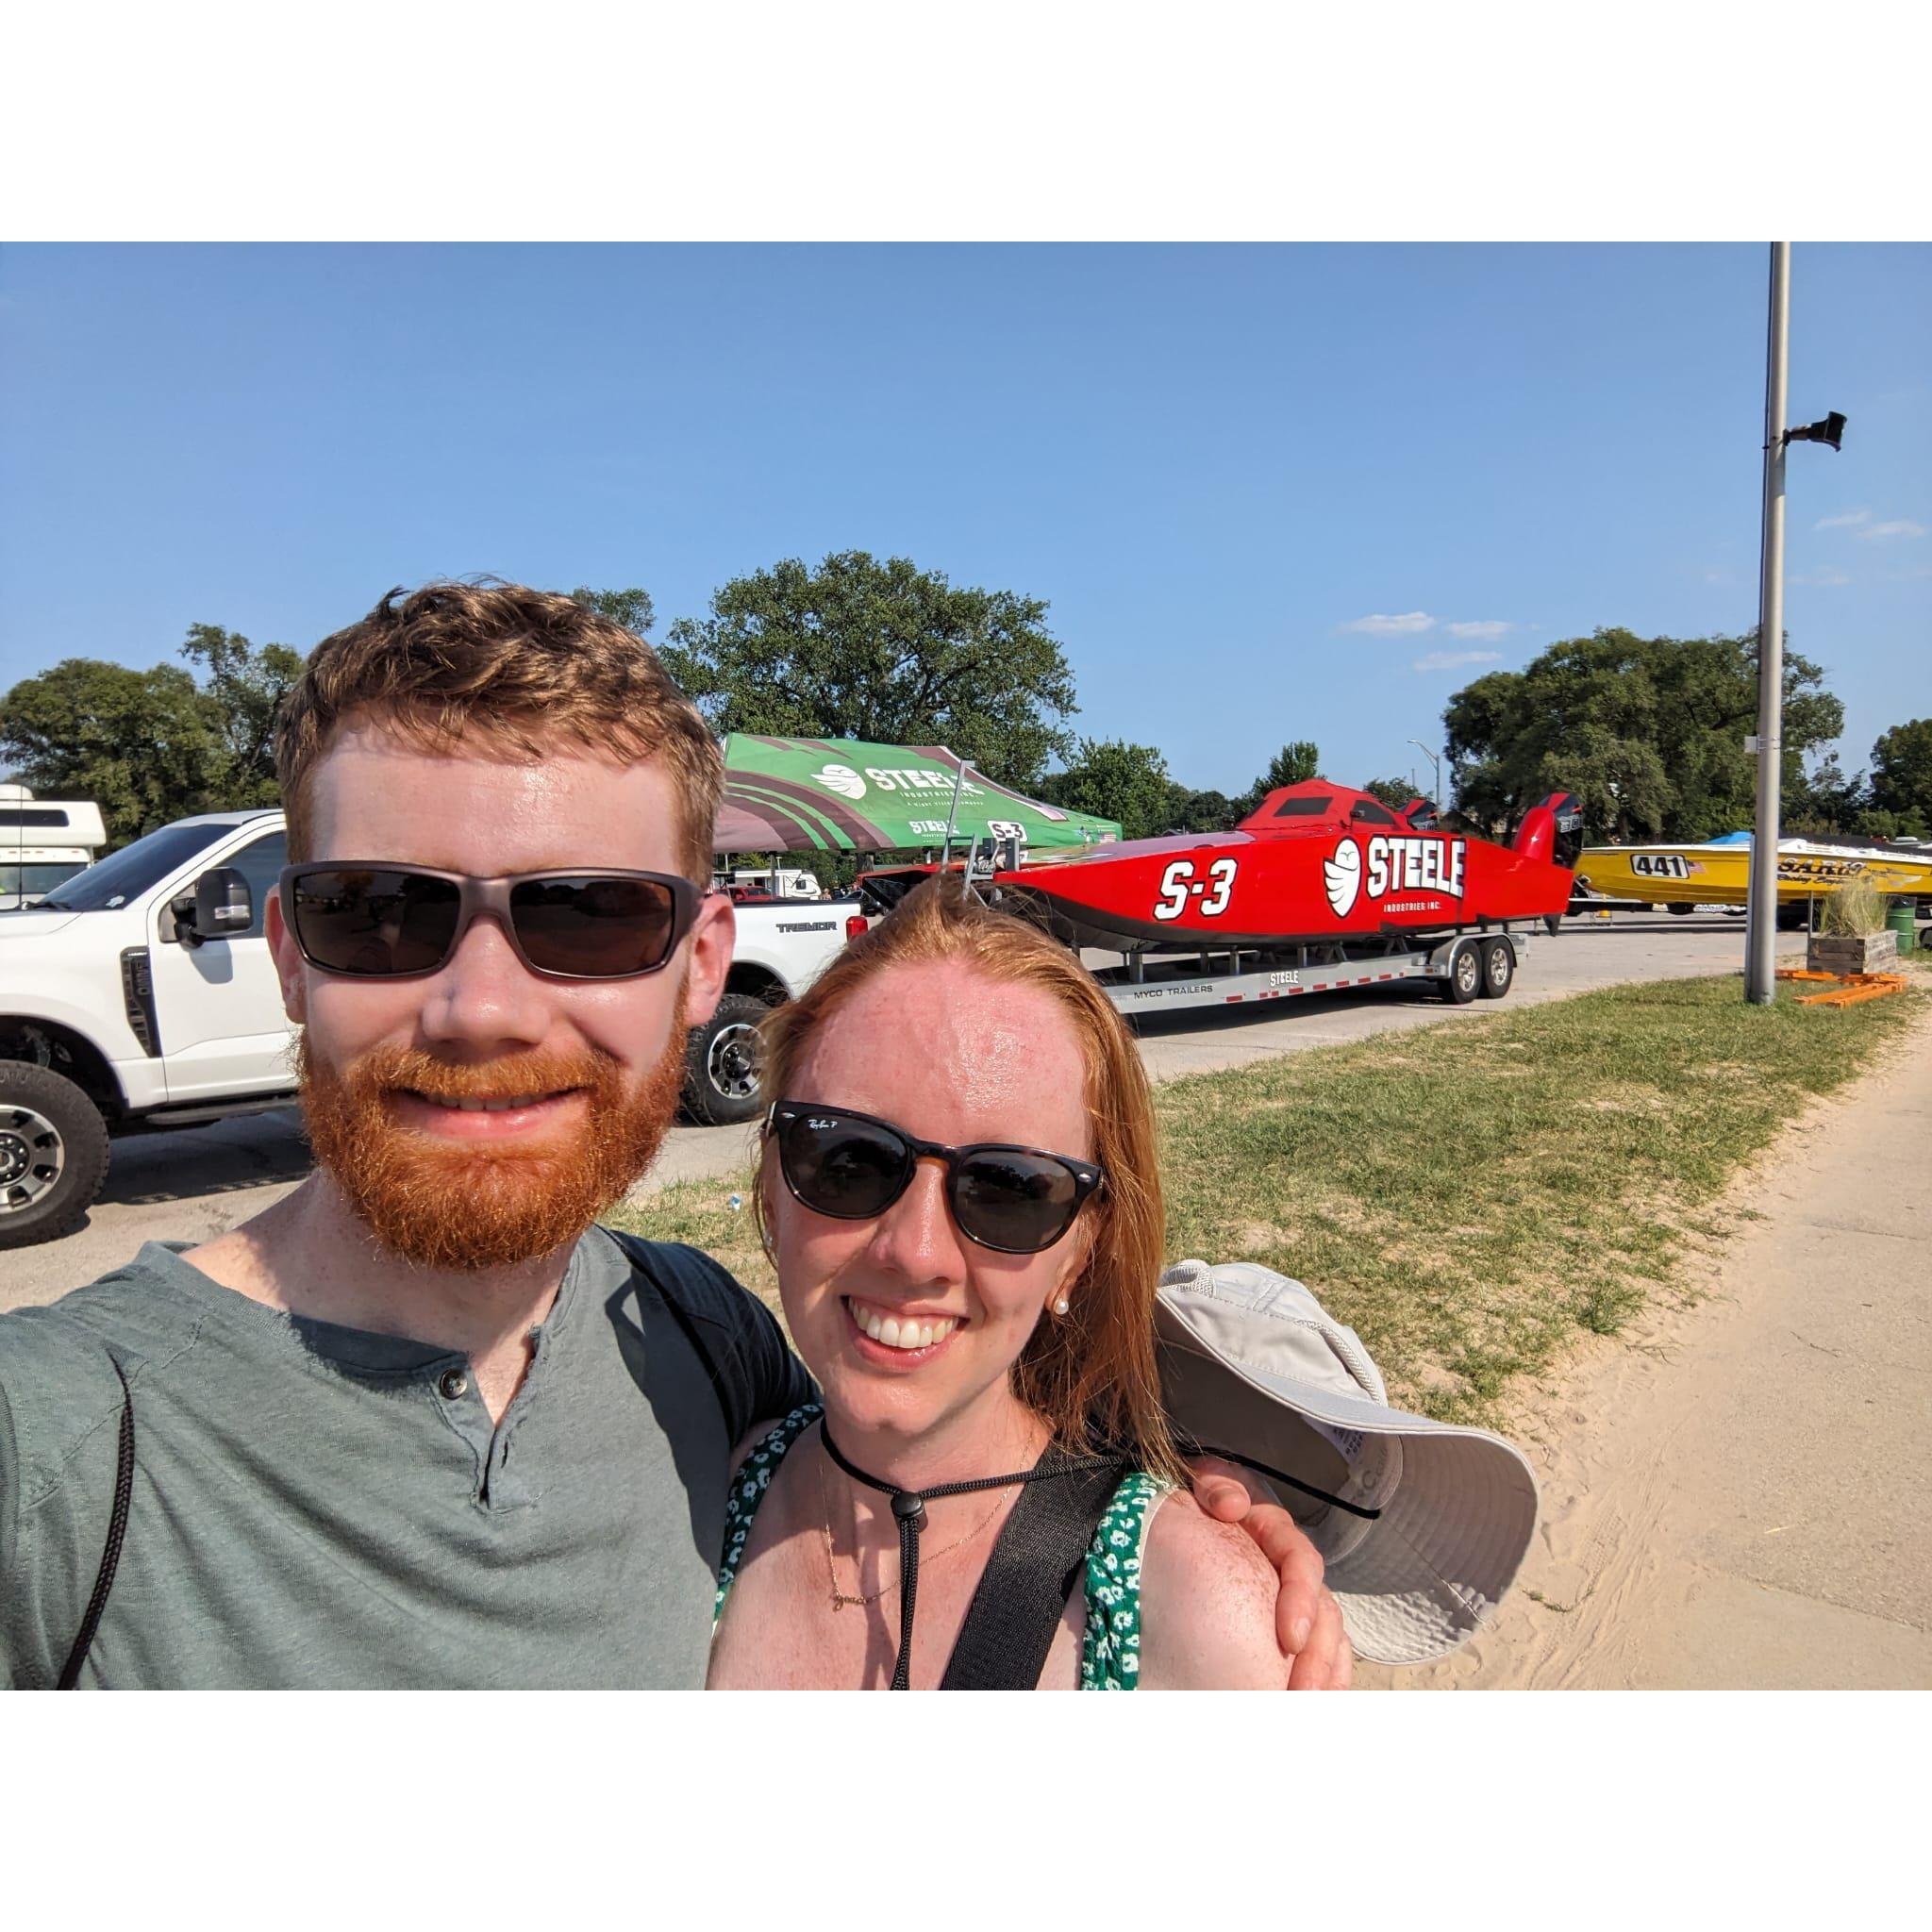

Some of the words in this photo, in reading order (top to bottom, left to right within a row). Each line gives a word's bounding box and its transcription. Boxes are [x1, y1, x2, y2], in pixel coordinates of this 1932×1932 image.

[991, 824, 1023, 839] S-3
[1367, 834, 1466, 899] STEELE
[1636, 857, 1682, 876] 441
[1153, 858, 1238, 921] S-3
[1383, 902, 1425, 912] INDUSTRIES
[775, 921, 838, 933] TREMOR
[1270, 970, 1299, 987] STEELE
[1134, 990, 1163, 999] MYCO
[1168, 985, 1213, 995] TRAILERS
